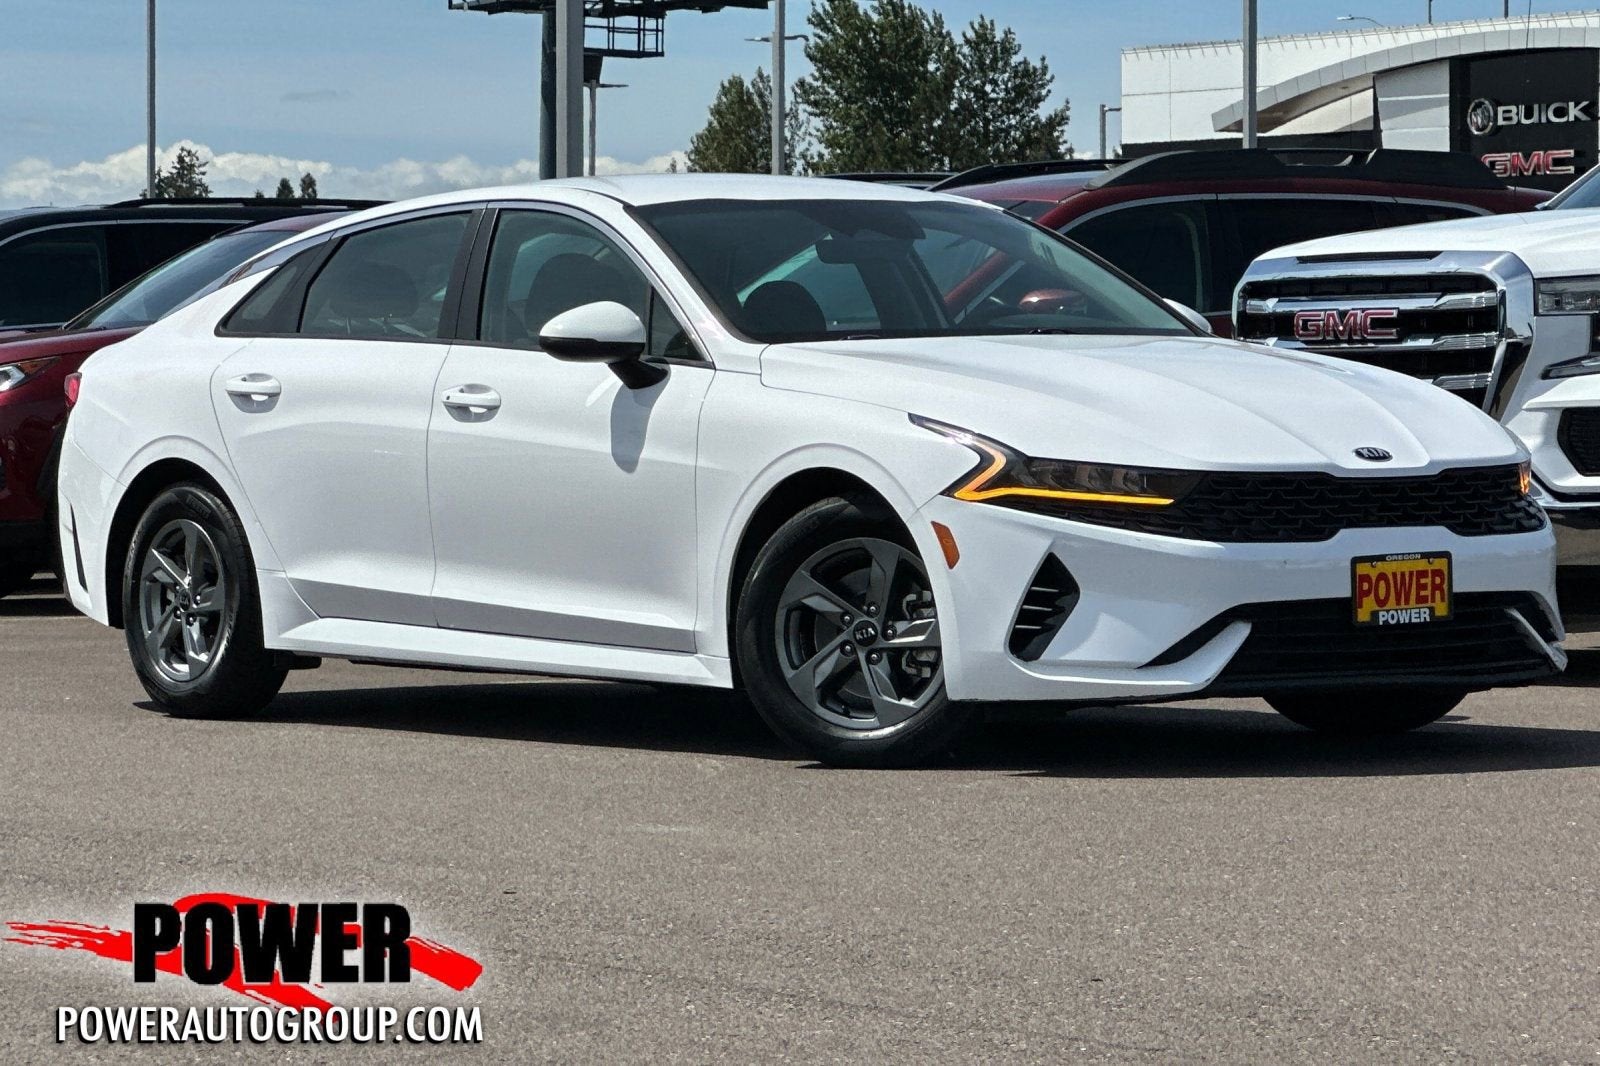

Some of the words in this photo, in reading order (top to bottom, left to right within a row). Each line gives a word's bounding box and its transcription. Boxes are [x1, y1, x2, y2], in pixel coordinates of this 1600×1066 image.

[1497, 101, 1591, 125] BUICK
[1481, 149, 1575, 177] GMC
[1294, 308, 1399, 341] GMC
[1358, 448, 1389, 457] KIA
[1357, 568, 1446, 608] POWER
[1379, 608, 1430, 625] POWER
[856, 628, 875, 640] KIA
